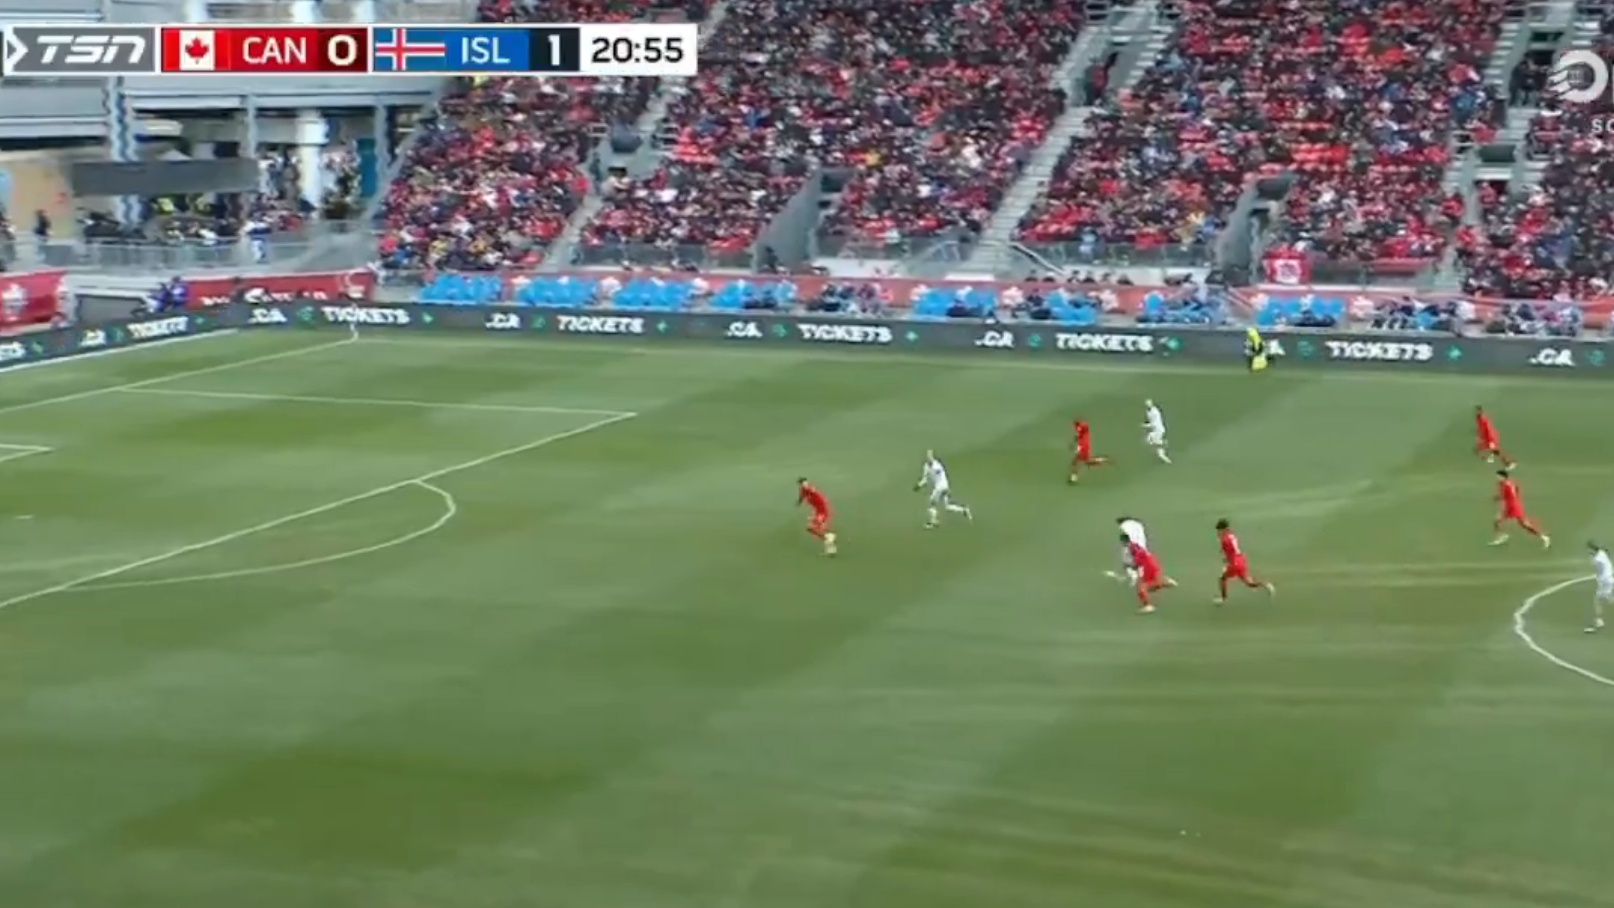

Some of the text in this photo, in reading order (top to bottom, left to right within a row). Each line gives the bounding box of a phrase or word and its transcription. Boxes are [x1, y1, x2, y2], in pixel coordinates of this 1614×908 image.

[321, 306, 410, 324] TICKETS
[556, 315, 644, 333] TICKETS
[726, 321, 892, 342] .CA TICKETS
[975, 330, 1153, 351] .CA TICKETS
[1325, 340, 1434, 360] TICKETS
[1529, 347, 1576, 367] .CA
